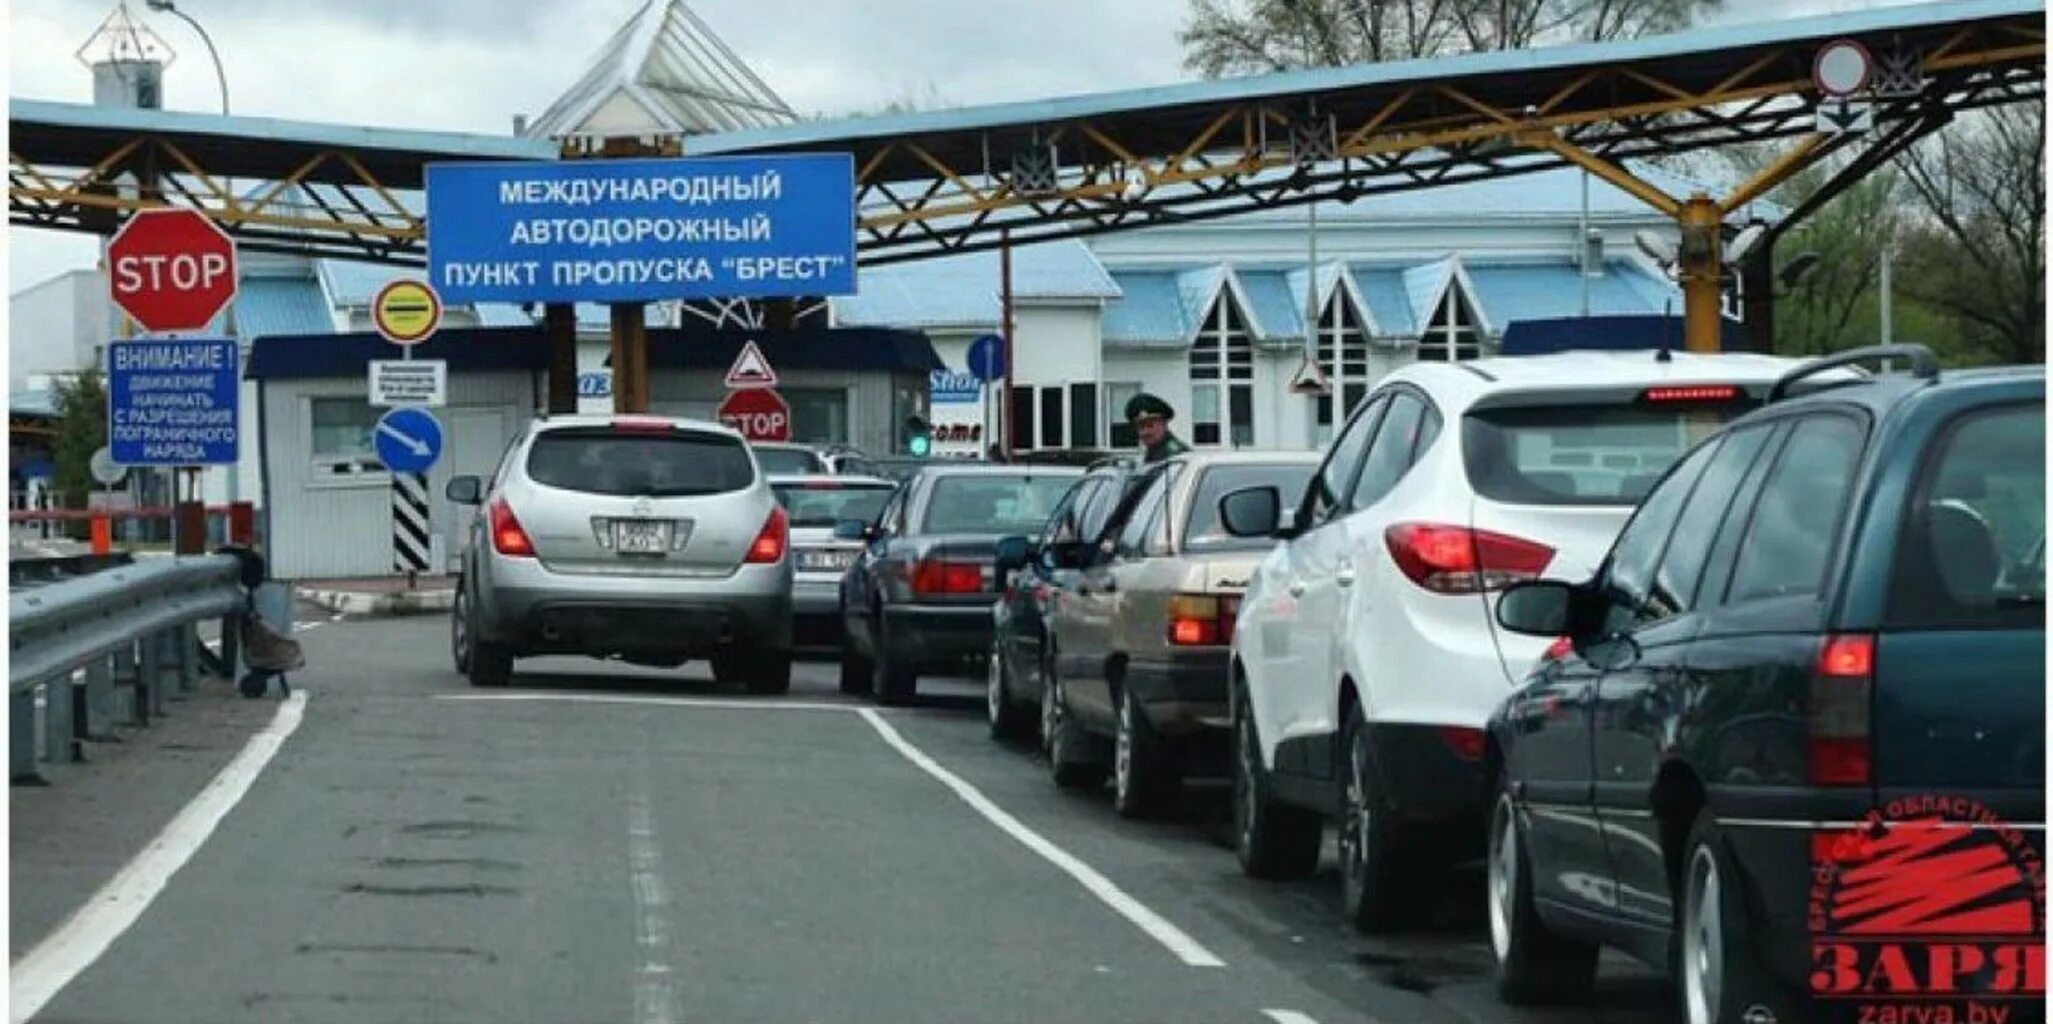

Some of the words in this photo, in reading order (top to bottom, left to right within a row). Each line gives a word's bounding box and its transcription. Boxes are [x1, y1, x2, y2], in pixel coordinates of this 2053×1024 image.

[500, 170, 782, 205] МЕЖДУНАРОДНЫЙ
[510, 212, 770, 246] АВТОДОРОЖНЫЙ
[116, 253, 227, 292] STOP
[445, 262, 539, 286] ПУНКТ
[553, 257, 714, 286] ПРОПУСКА
[115, 345, 223, 370] ВНИМАНИЕ
[129, 374, 216, 390] ДВИЖЕНИЕ
[131, 392, 214, 407] НАЧИНАТЬ
[128, 409, 233, 424] РАЗРЕШЕНИЯ
[114, 426, 235, 443] ПОГРАНИЧНОГО
